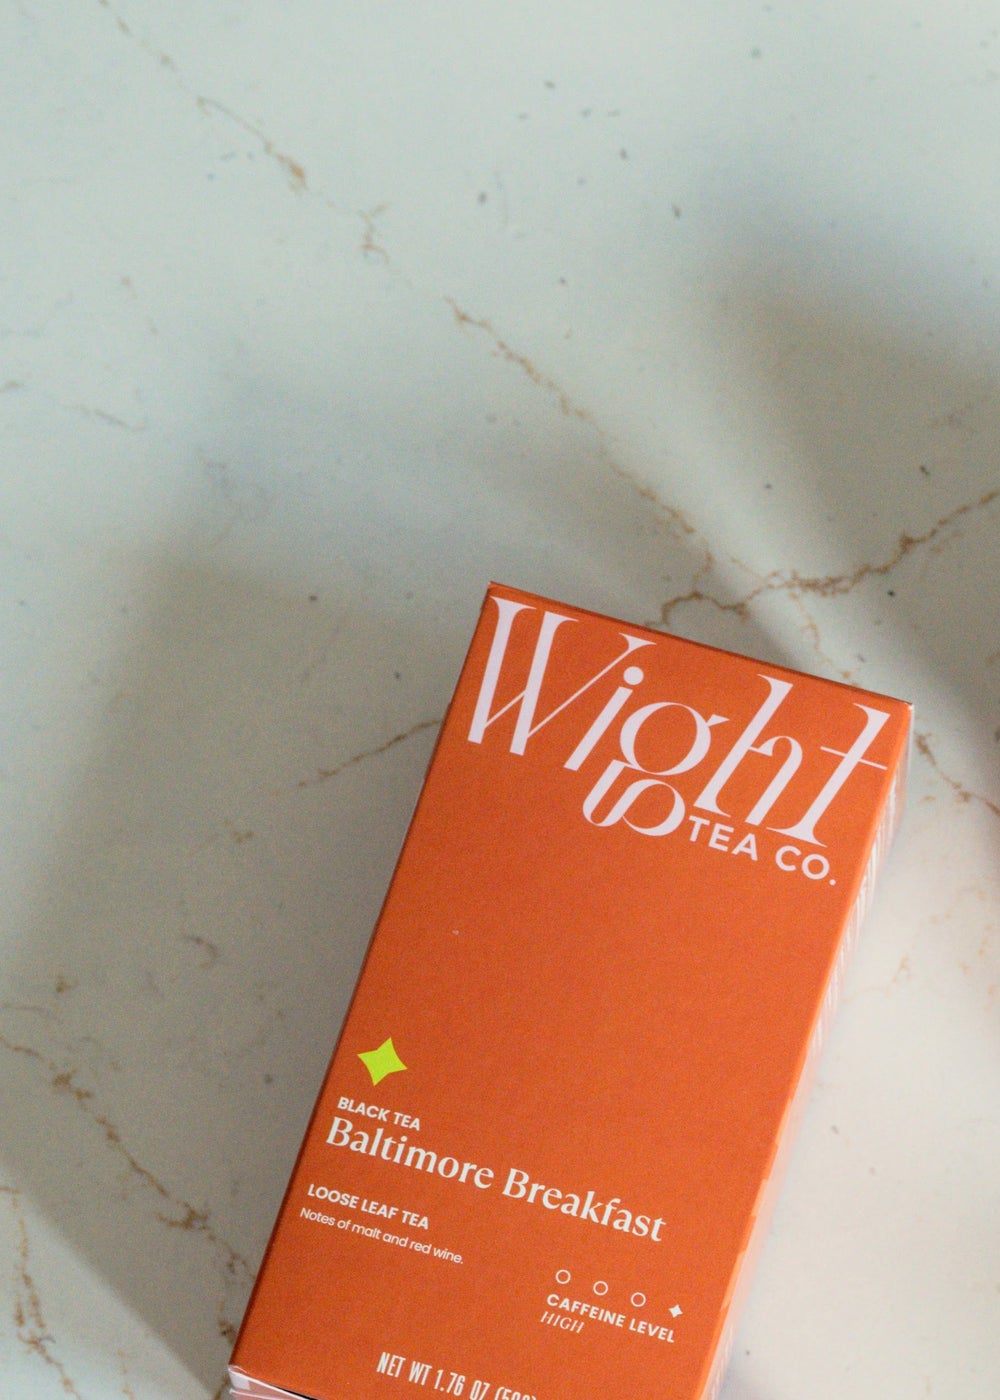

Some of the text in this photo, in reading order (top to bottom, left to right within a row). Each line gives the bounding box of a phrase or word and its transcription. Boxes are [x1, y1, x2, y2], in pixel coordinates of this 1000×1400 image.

[468, 596, 890, 847] Wight
[689, 817, 837, 885] TEA CO.
[337, 1096, 420, 1131] BLACK TEA
[325, 1116, 666, 1242] Baltimore Breakfast
[307, 1184, 429, 1230] LOOSE LEAF TEA
[300, 1208, 464, 1265] Notes of malt and red wine.
[540, 1313, 584, 1334] HIGH
[547, 1293, 675, 1343] CAFFEINE LEVEL
[377, 1352, 406, 1376] NET
[409, 1362, 432, 1385] WT
[434, 1369, 465, 1396] 1.76
